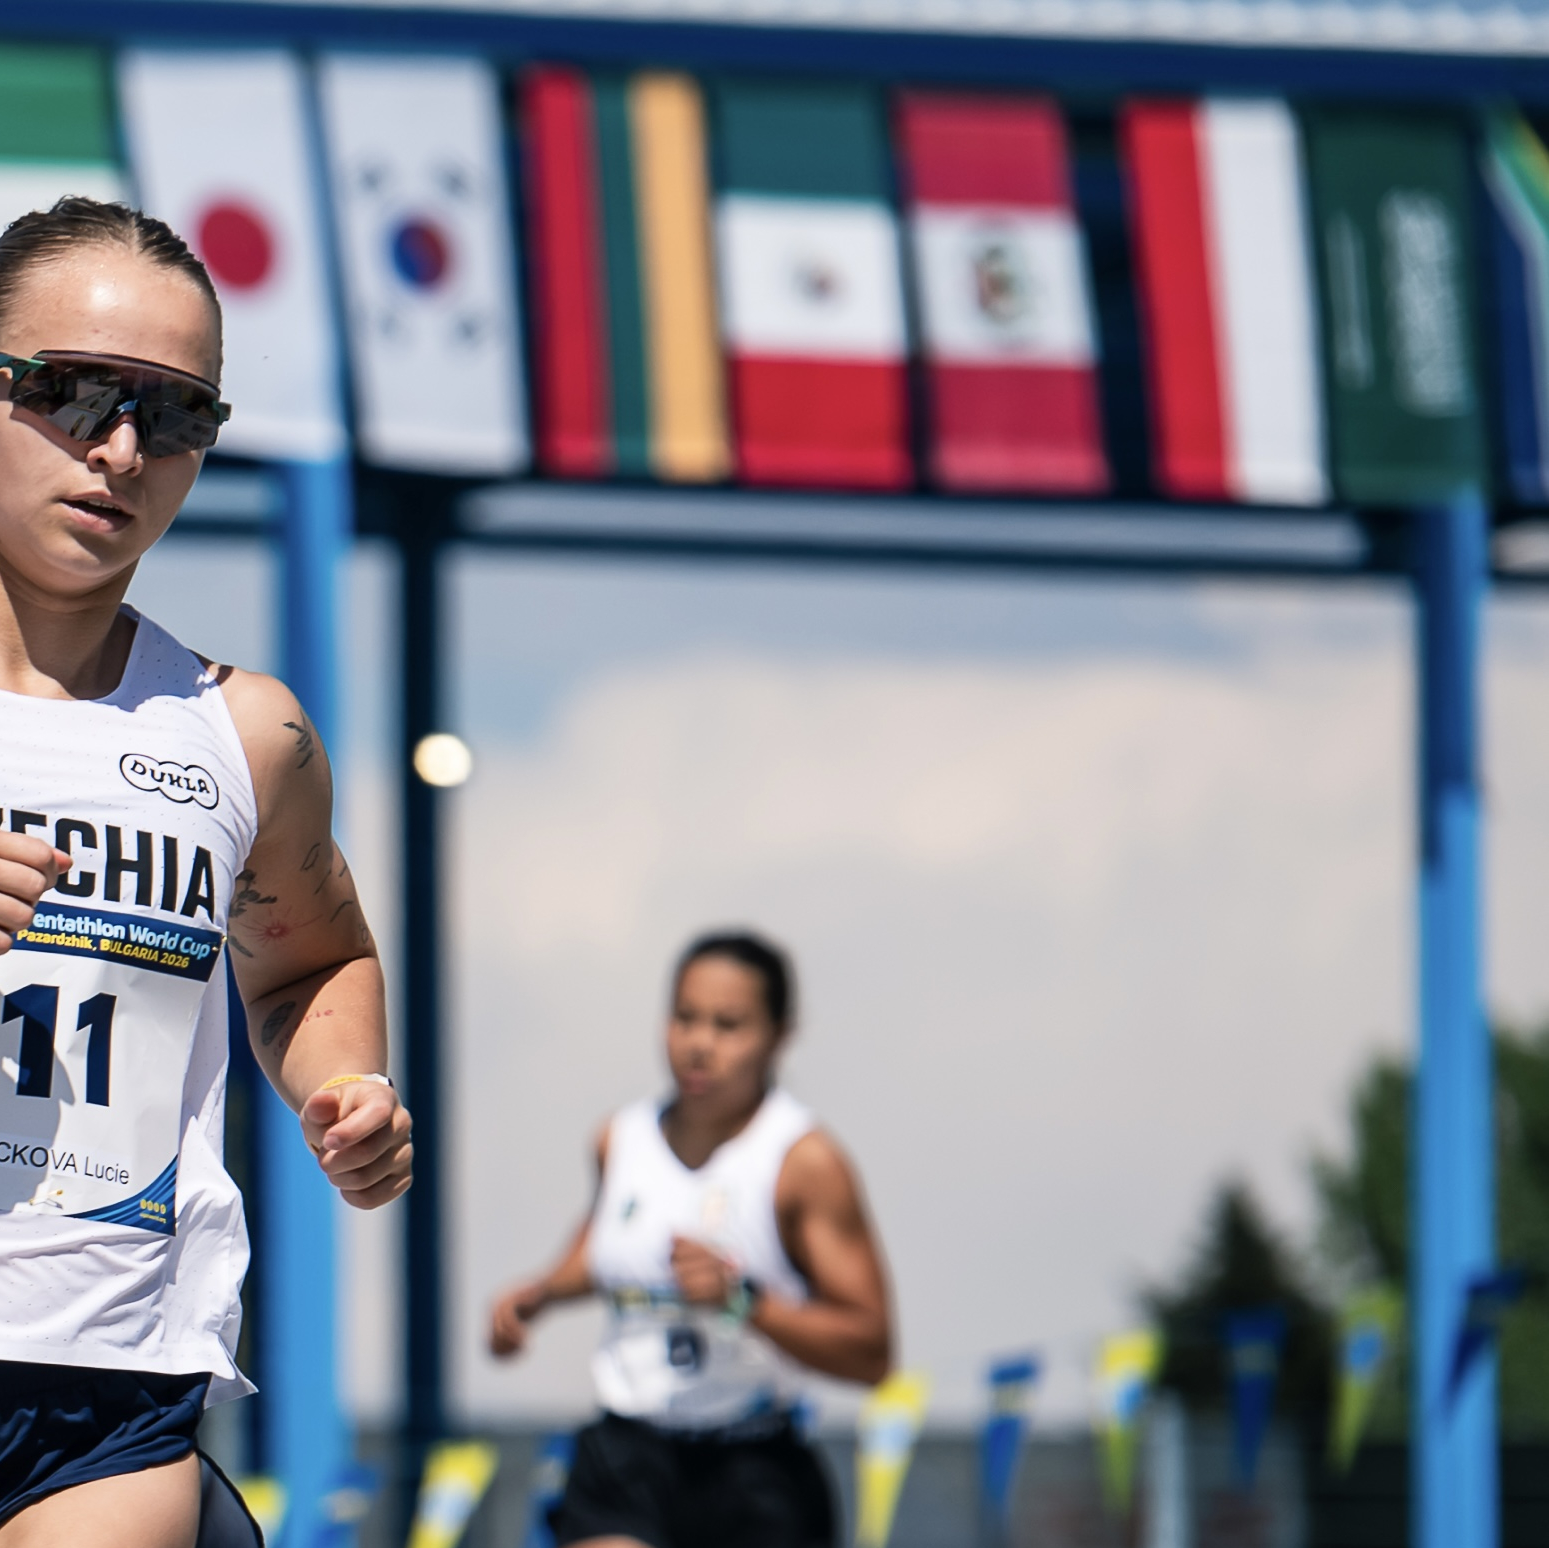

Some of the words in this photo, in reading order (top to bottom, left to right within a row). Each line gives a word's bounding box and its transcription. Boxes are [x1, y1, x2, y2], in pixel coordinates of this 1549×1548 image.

[130, 759, 211, 794] DUKLA
[16, 928, 97, 951] Pazardzhik,
[100, 939, 159, 963] BULGARIA
[159, 951, 190, 969] 2026
[32, 912, 126, 939] entathlon
[128, 924, 180, 951] World
[180, 936, 210, 960] Cup
[1, 983, 118, 1108] 11
[84, 1156, 130, 1185] Lucie
